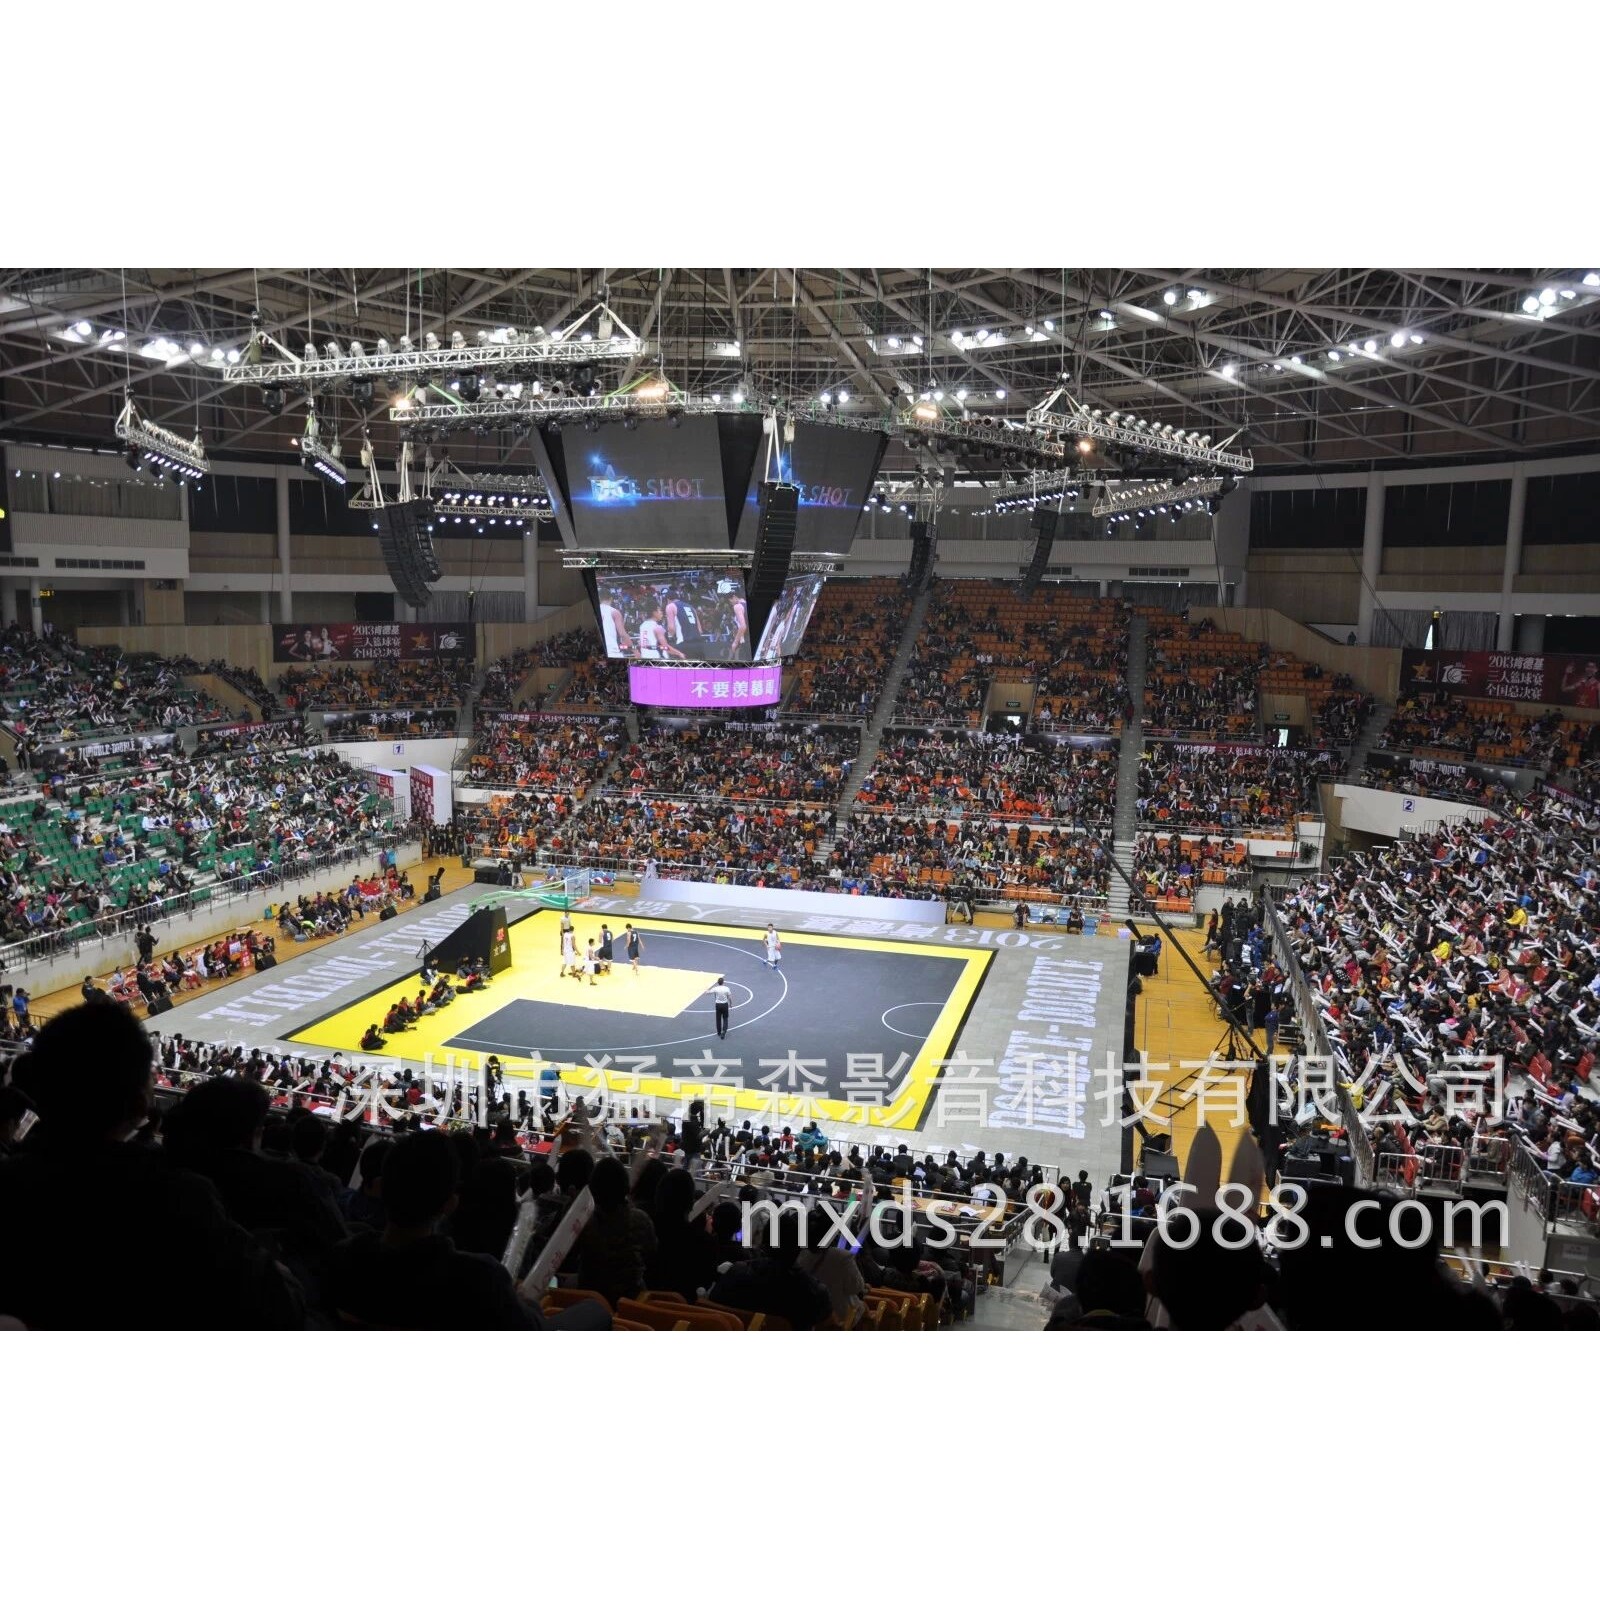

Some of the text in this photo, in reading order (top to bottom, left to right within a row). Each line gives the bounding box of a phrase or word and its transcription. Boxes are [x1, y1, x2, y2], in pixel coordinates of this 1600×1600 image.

[646, 478, 704, 498] SHOT
[1488, 655, 1545, 671] 2013肯德基
[1487, 669, 1544, 685] 三人篮球赛
[1486, 683, 1543, 700] 全国总决赛
